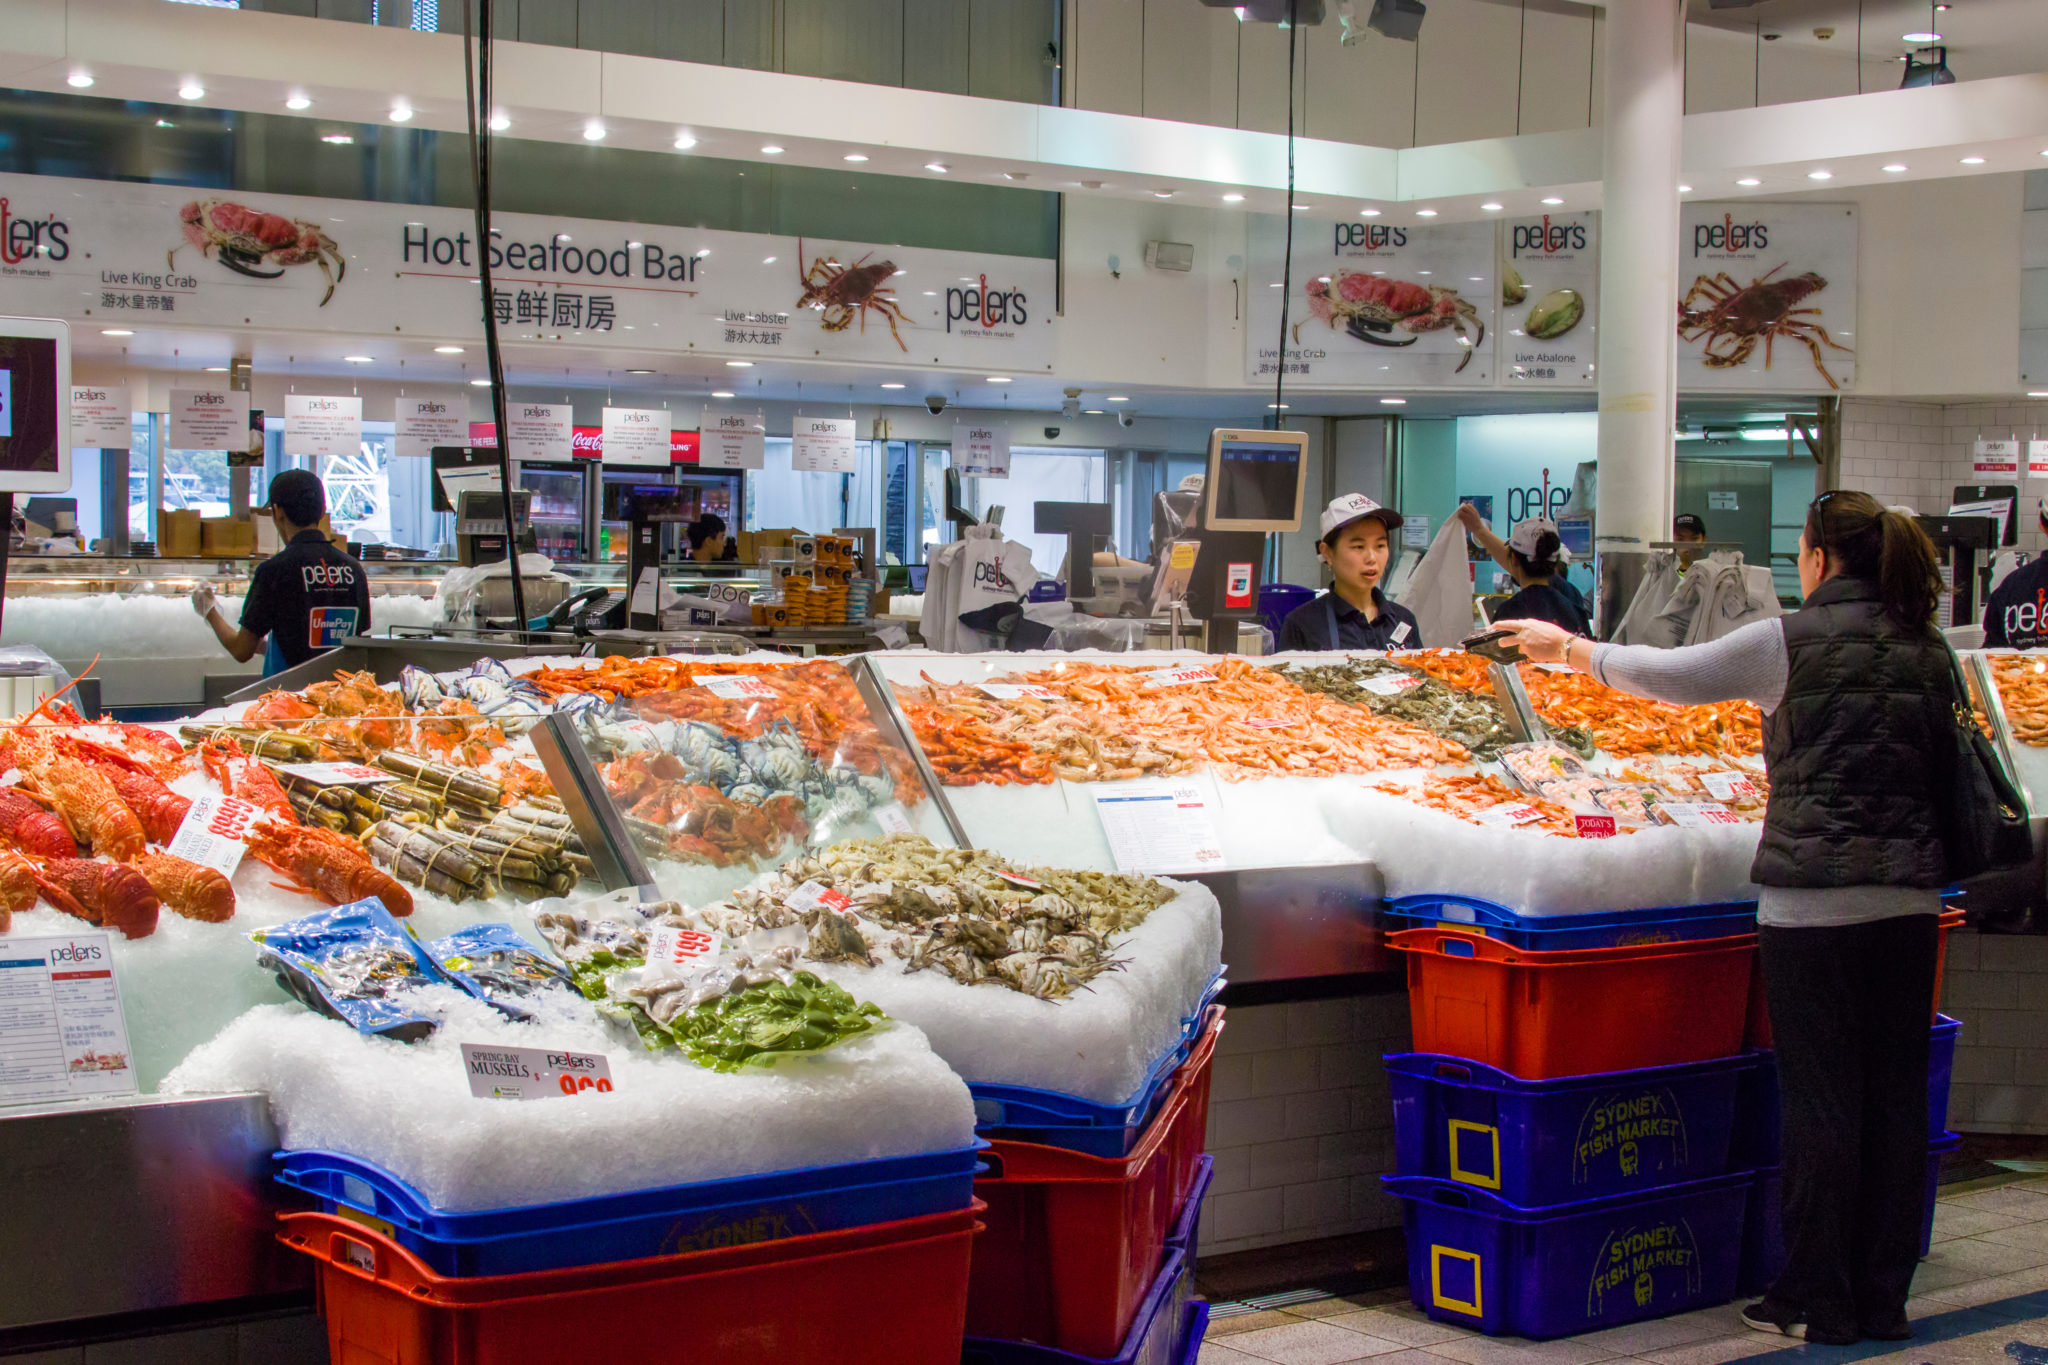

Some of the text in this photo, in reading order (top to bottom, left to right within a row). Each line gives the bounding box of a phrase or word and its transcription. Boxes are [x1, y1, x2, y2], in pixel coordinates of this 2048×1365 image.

[404, 226, 702, 282] Hot Seafood Bar
[1513, 214, 1586, 258] peter's
[1695, 213, 1768, 258] peter's
[101, 270, 197, 289] Live King Crab
[101, 292, 174, 311] 游水皇帝蟹
[481, 287, 616, 331] 海鲜厨房
[725, 309, 789, 325] Live Lobster
[946, 273, 1028, 333] peter's
[725, 329, 783, 345] 游水大龙虾
[1259, 349, 1278, 358] Live
[1515, 352, 1577, 363] Live Abalone
[207, 798, 254, 840] 8999
[1580, 819, 1613, 829] TODAY'S
[470, 1061, 530, 1078] MUSSELS
[472, 1051, 520, 1064] SPRING BAY
[1594, 1094, 1664, 1131] SYDNEY
[1579, 1118, 1680, 1165] FISH MARKET
[1610, 1225, 1678, 1263] SYDNEY
[1594, 1248, 1693, 1297] FISH MARKET
